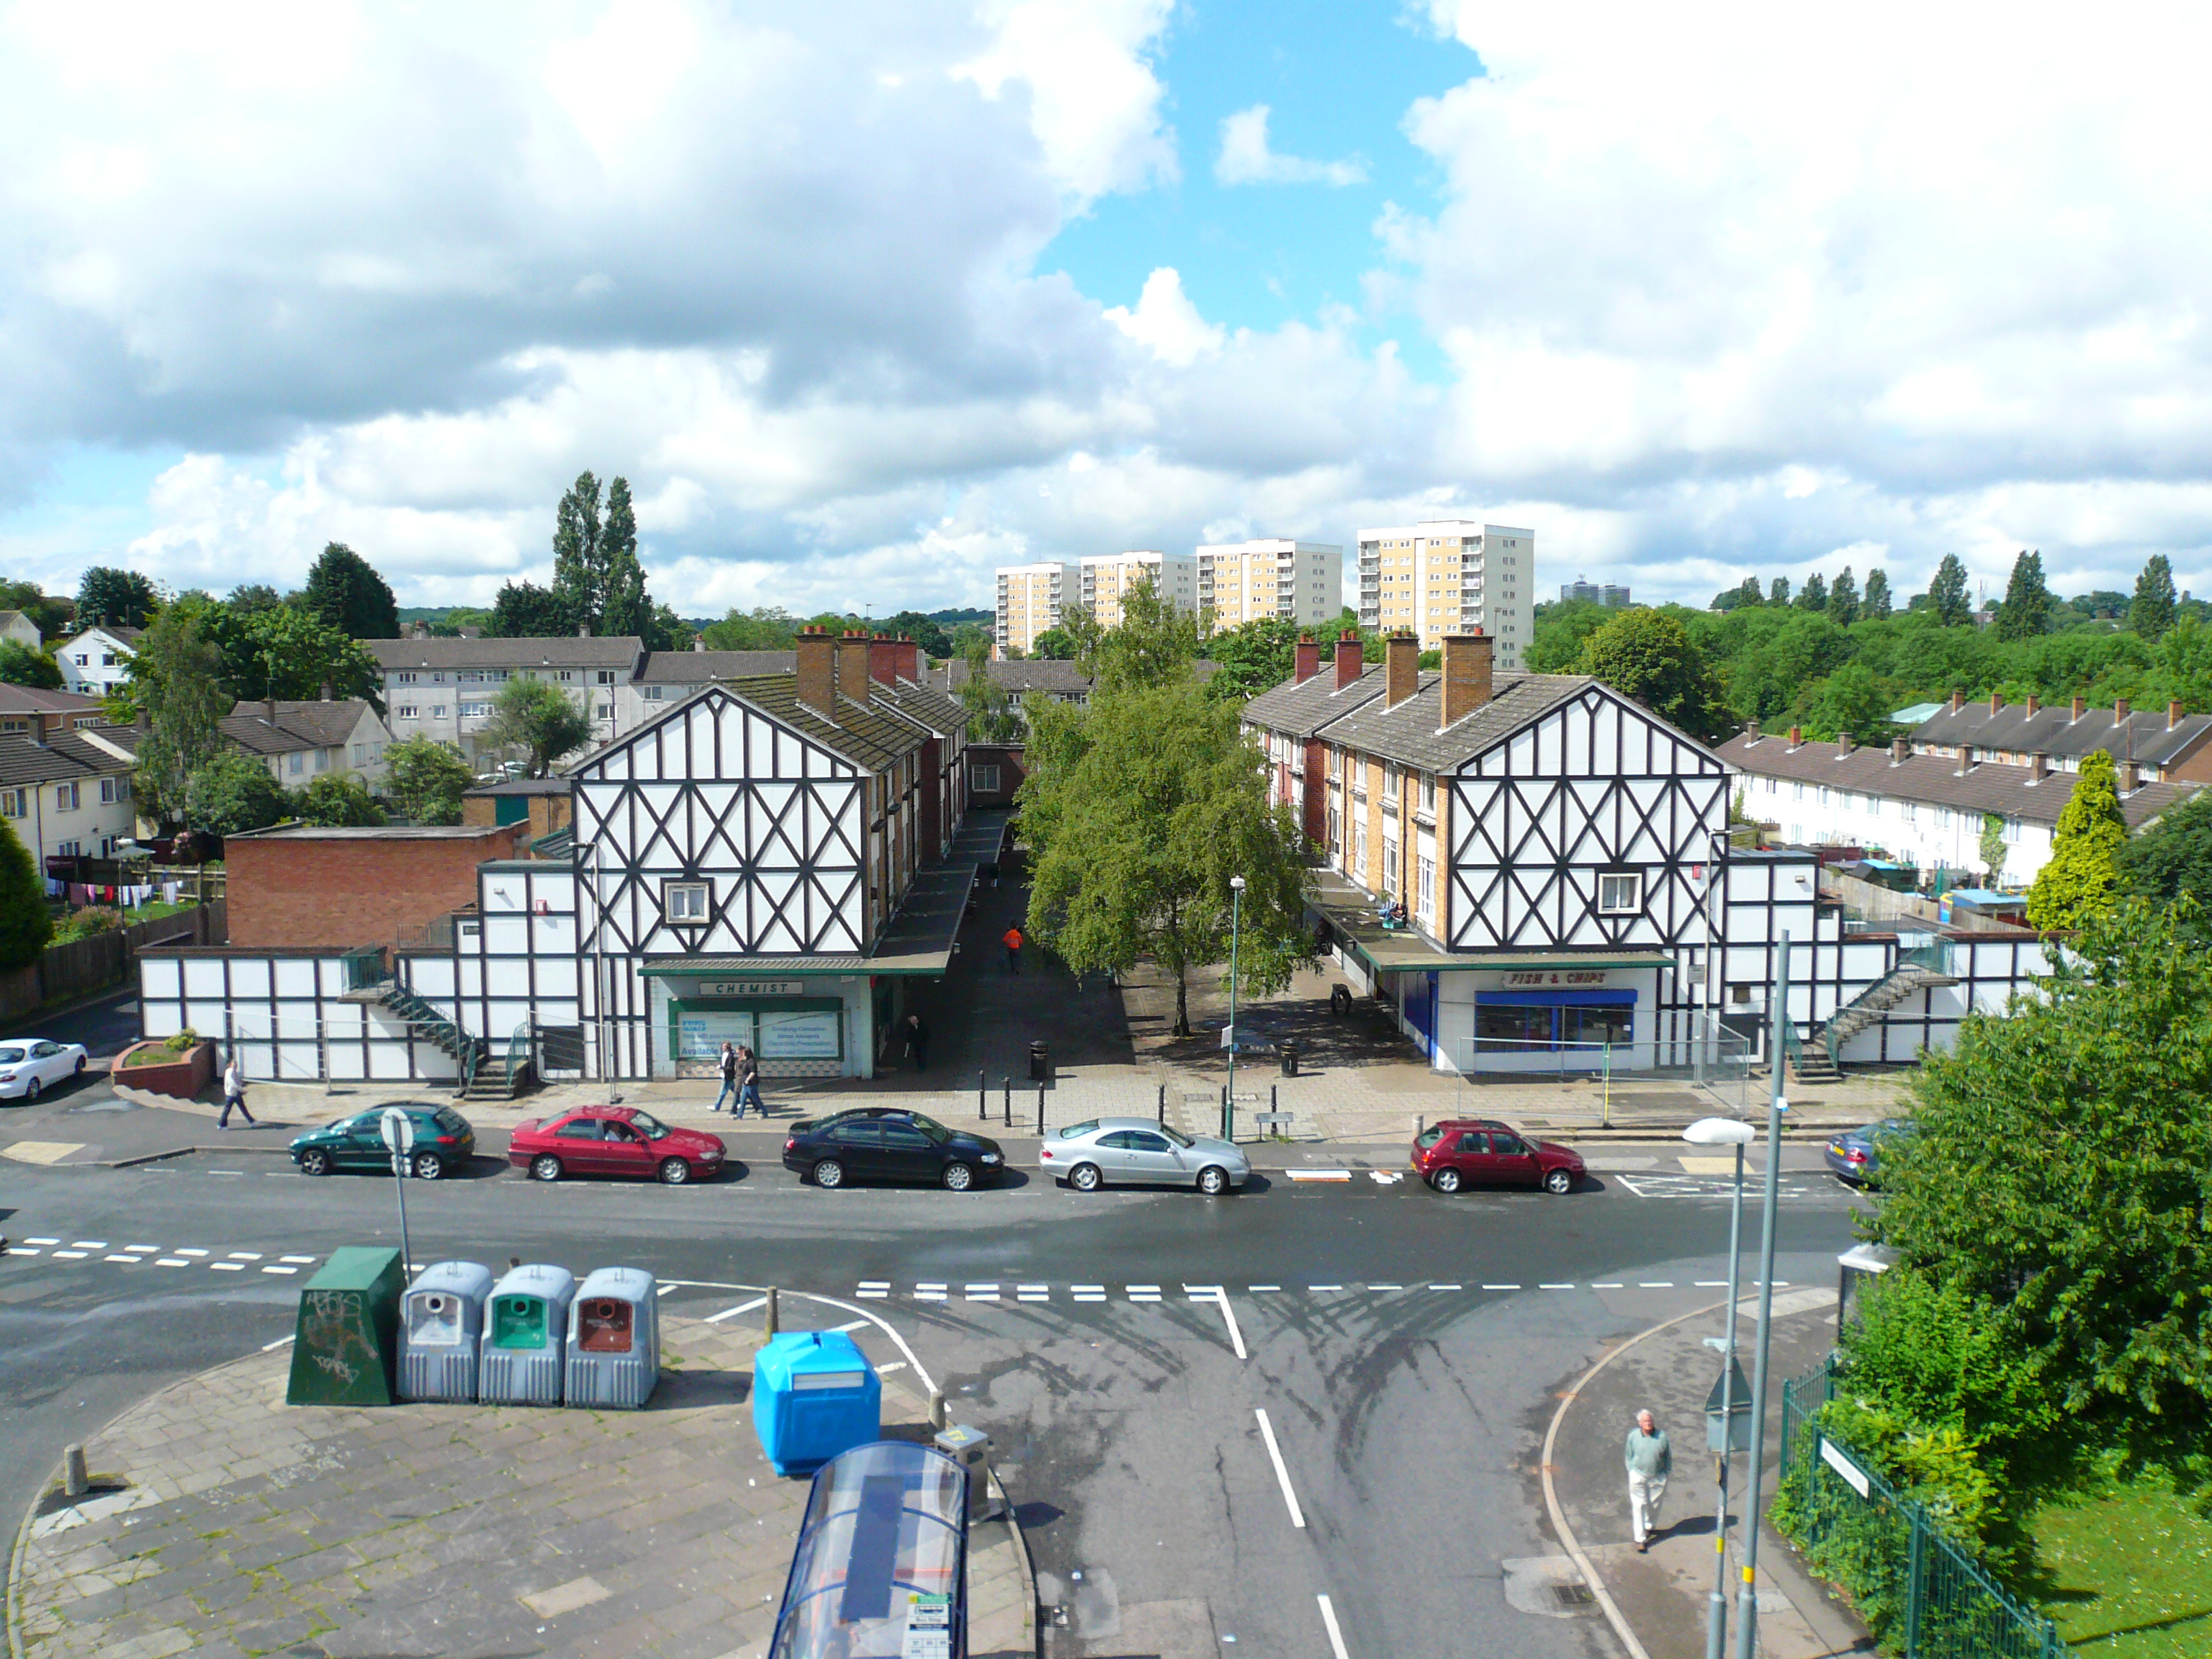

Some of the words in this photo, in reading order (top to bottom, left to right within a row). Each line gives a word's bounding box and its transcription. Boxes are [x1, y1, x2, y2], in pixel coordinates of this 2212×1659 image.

[1509, 973, 1545, 985] FISH
[1550, 973, 1559, 984] &
[1566, 972, 1606, 984] CHIPS
[715, 984, 788, 994] CHEMIST
[682, 1047, 719, 1056] Available
